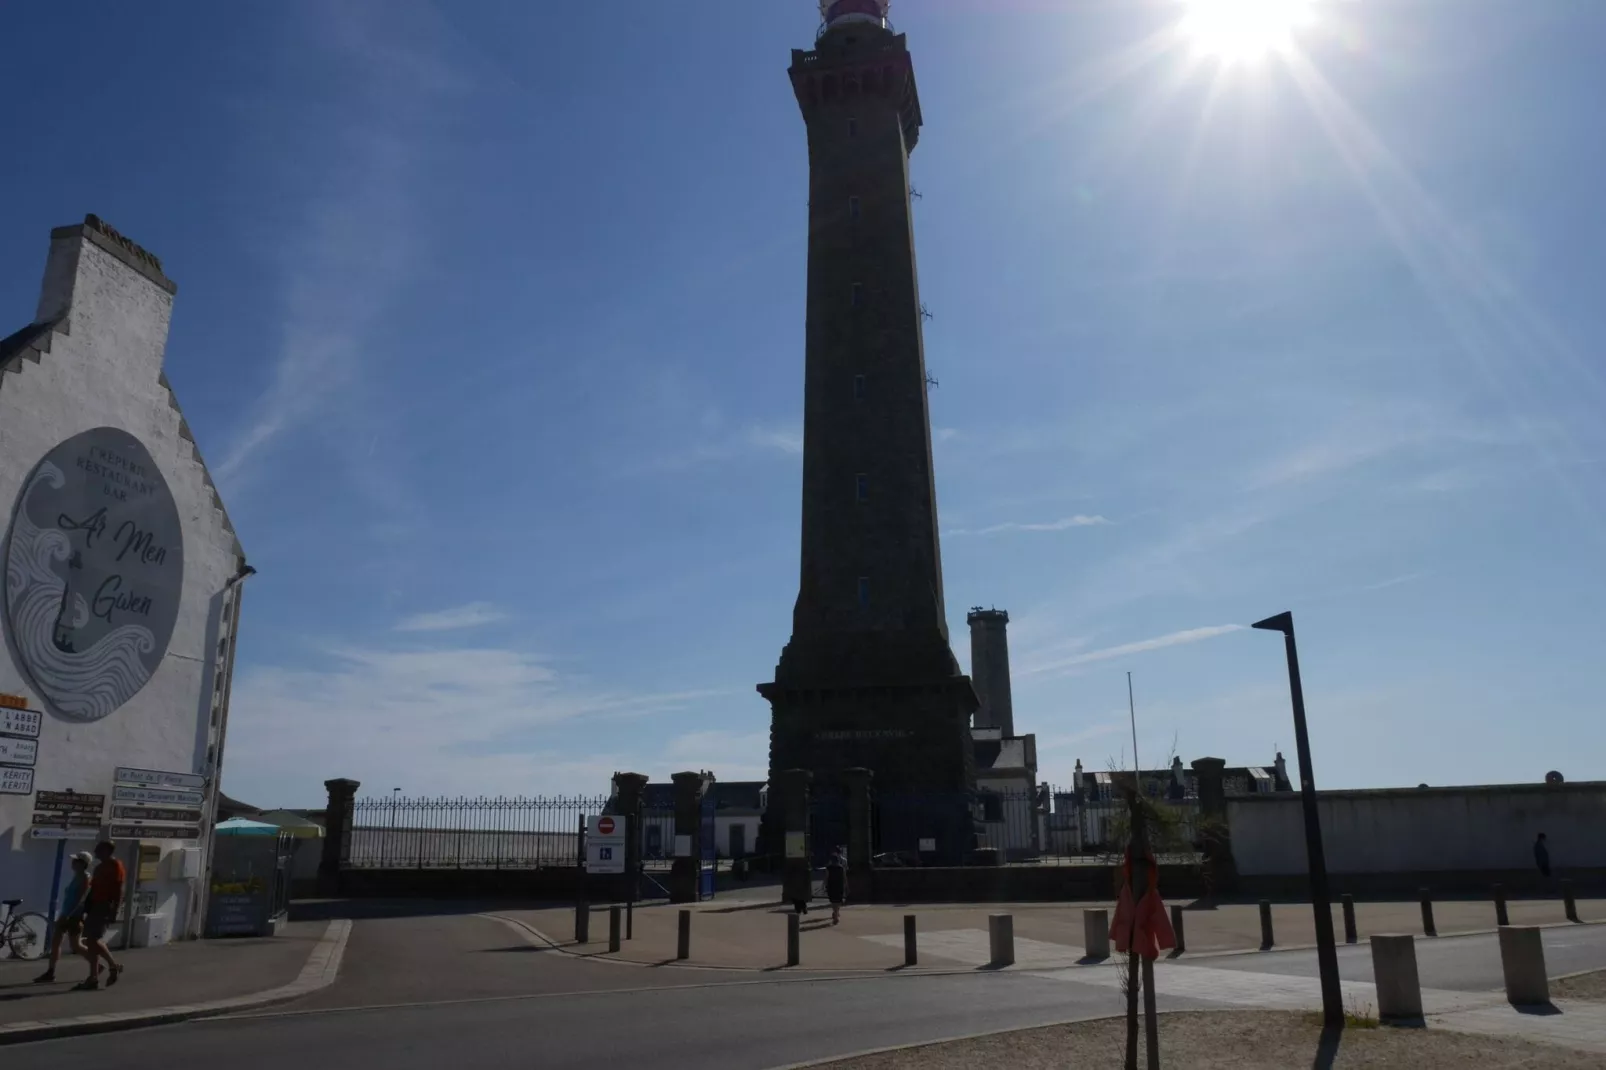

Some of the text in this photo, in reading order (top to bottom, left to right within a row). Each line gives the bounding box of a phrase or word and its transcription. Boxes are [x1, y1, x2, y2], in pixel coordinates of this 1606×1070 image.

[77, 456, 155, 497] RESTAURANT
[104, 483, 127, 502] BAR
[58, 507, 166, 565] Ar Men
[92, 574, 152, 623] Gwen
[14, 723, 37, 733] ABAD
